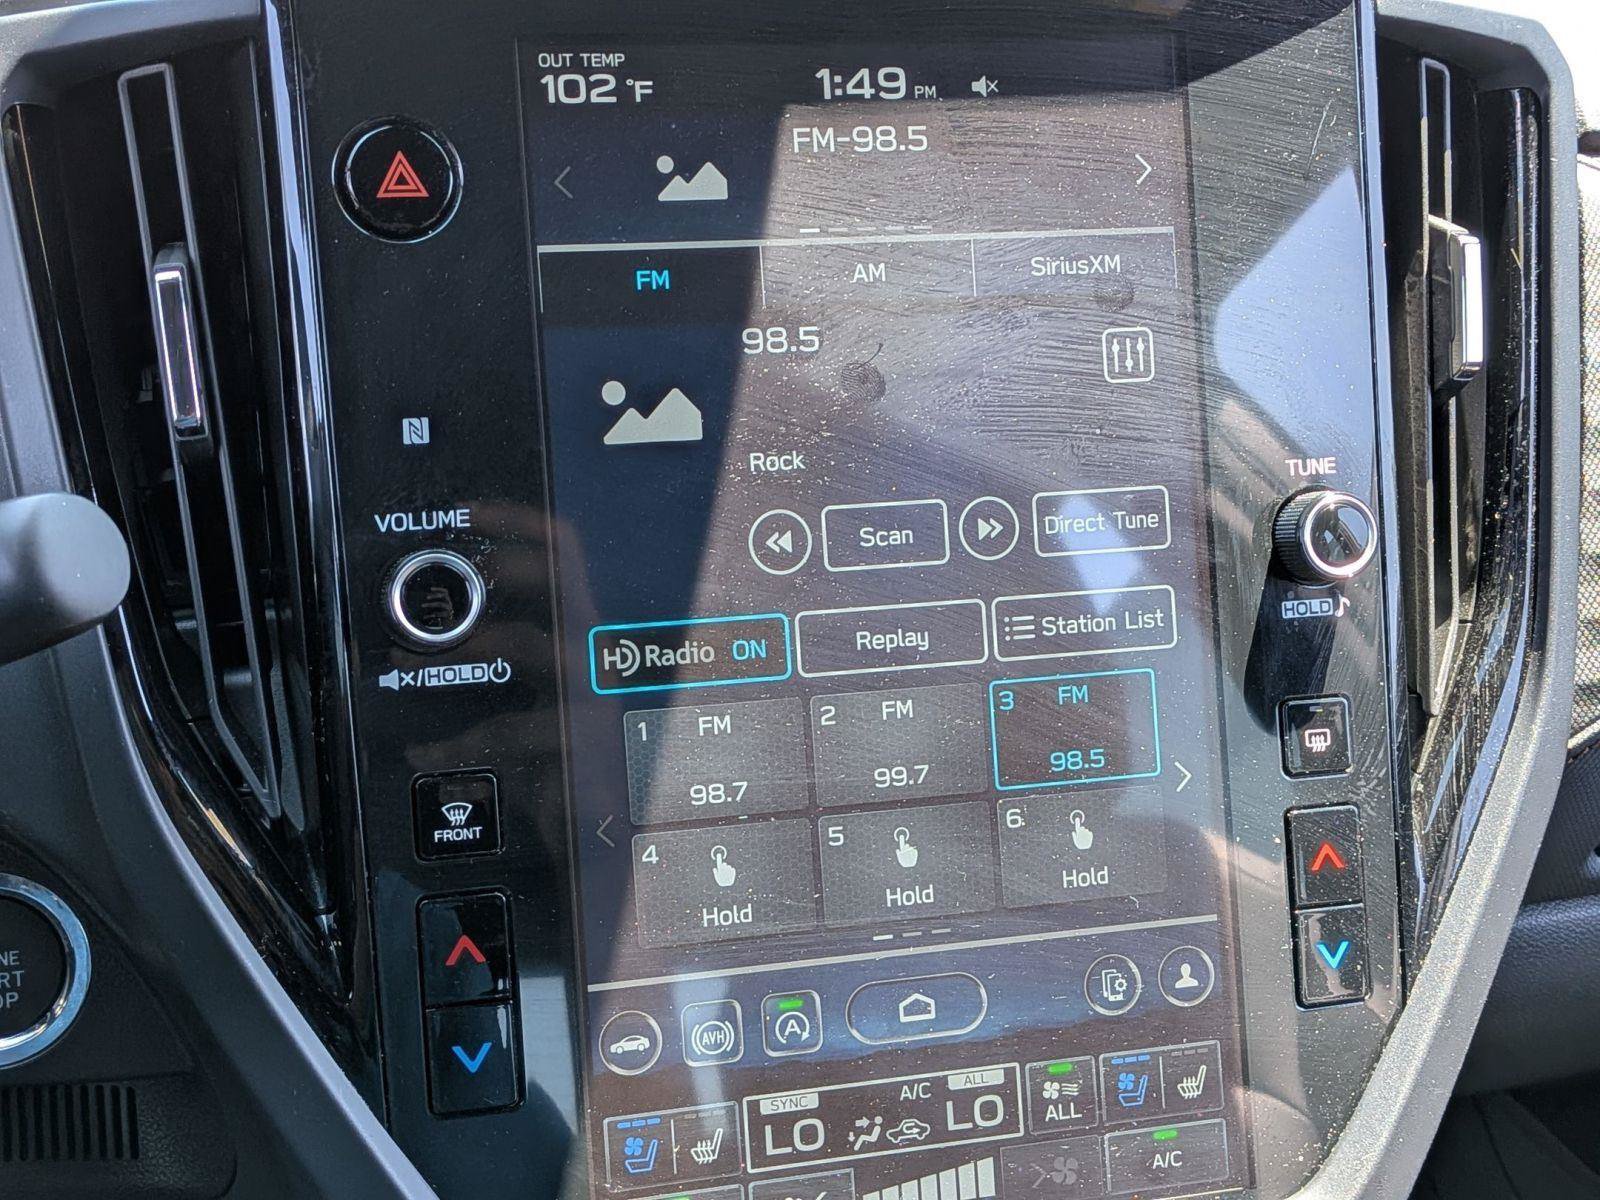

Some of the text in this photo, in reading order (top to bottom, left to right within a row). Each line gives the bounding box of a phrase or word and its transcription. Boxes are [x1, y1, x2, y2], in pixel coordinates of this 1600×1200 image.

[537, 52, 626, 68] OUT TEMP
[540, 73, 618, 104] 102
[814, 66, 937, 100] 1:49 PM
[791, 125, 928, 153] FM-98.5
[851, 263, 887, 283] AM
[1030, 254, 1122, 279] SiriusXM
[635, 269, 670, 291] FM
[741, 326, 820, 354] 98.5
[749, 451, 806, 473] Rock
[1285, 457, 1336, 476] TUNE
[374, 509, 471, 533] VOLUME
[1044, 509, 1160, 536] Direct Tune
[859, 526, 914, 548] Scan
[1282, 599, 1334, 619] HOLD
[1041, 608, 1165, 637] Station List
[856, 628, 930, 654] Replay
[645, 640, 715, 668] Radio
[732, 638, 767, 662] ON
[999, 691, 1015, 712] 3
[1058, 685, 1090, 706] FM
[819, 705, 836, 726] 2
[881, 700, 914, 722] FM
[637, 722, 648, 742] 1
[698, 715, 732, 737] FM
[1050, 748, 1106, 772] 98.5
[873, 765, 930, 789] 99.7
[689, 781, 749, 806] 98.7
[1006, 808, 1020, 829] 6
[434, 827, 482, 843] FRONT
[827, 826, 844, 847] 5
[641, 845, 659, 865] 4
[1062, 865, 1109, 889] Hold
[885, 884, 935, 908] Hold
[702, 902, 754, 926] Hold
[701, 1031, 726, 1045] AVH
[963, 1072, 990, 1086] ALL
[769, 1096, 809, 1111] SYNC
[900, 1084, 932, 1101] A/C
[945, 1095, 1004, 1131] LO
[1045, 1104, 1082, 1122] ALL
[764, 1118, 825, 1156] LO
[1153, 1152, 1183, 1169] A/C
